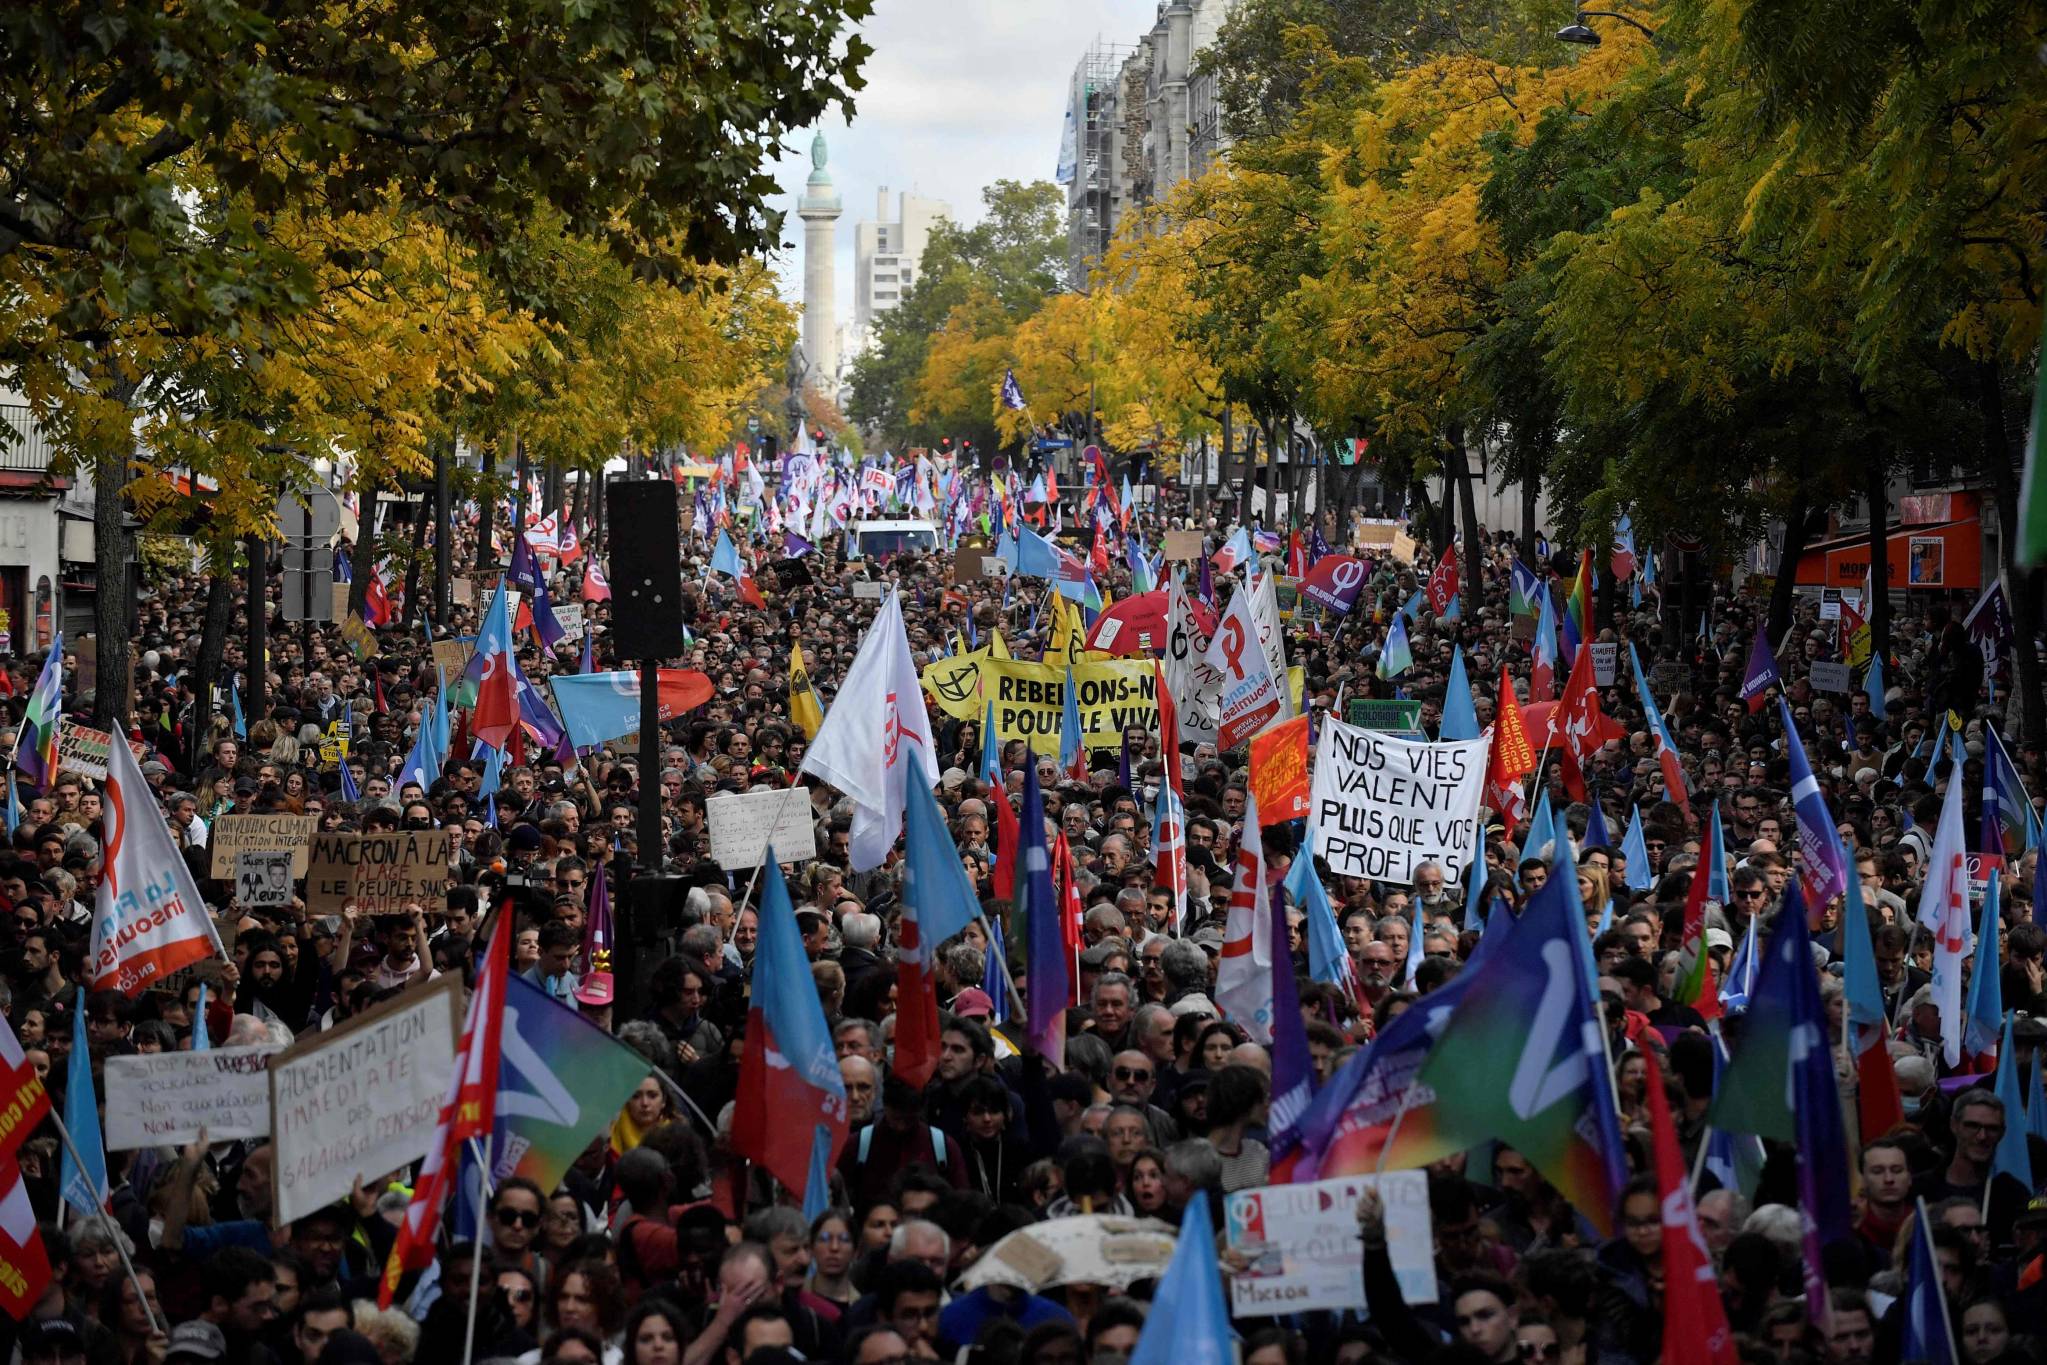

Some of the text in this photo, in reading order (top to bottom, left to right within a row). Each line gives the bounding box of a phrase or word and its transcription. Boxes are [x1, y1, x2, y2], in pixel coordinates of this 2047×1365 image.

[1332, 729, 1386, 771] NOS
[1505, 703, 1532, 769] fédération
[1337, 765, 1459, 811] VALENT
[1320, 798, 1473, 850] PLUS QUE VOS
[311, 838, 401, 866] MACRON
[426, 837, 450, 866] LA
[355, 863, 411, 881] PLAGE
[319, 880, 348, 896] LE
[356, 880, 414, 897] PEUPLE
[280, 1007, 425, 1098] AUGMENTATION
